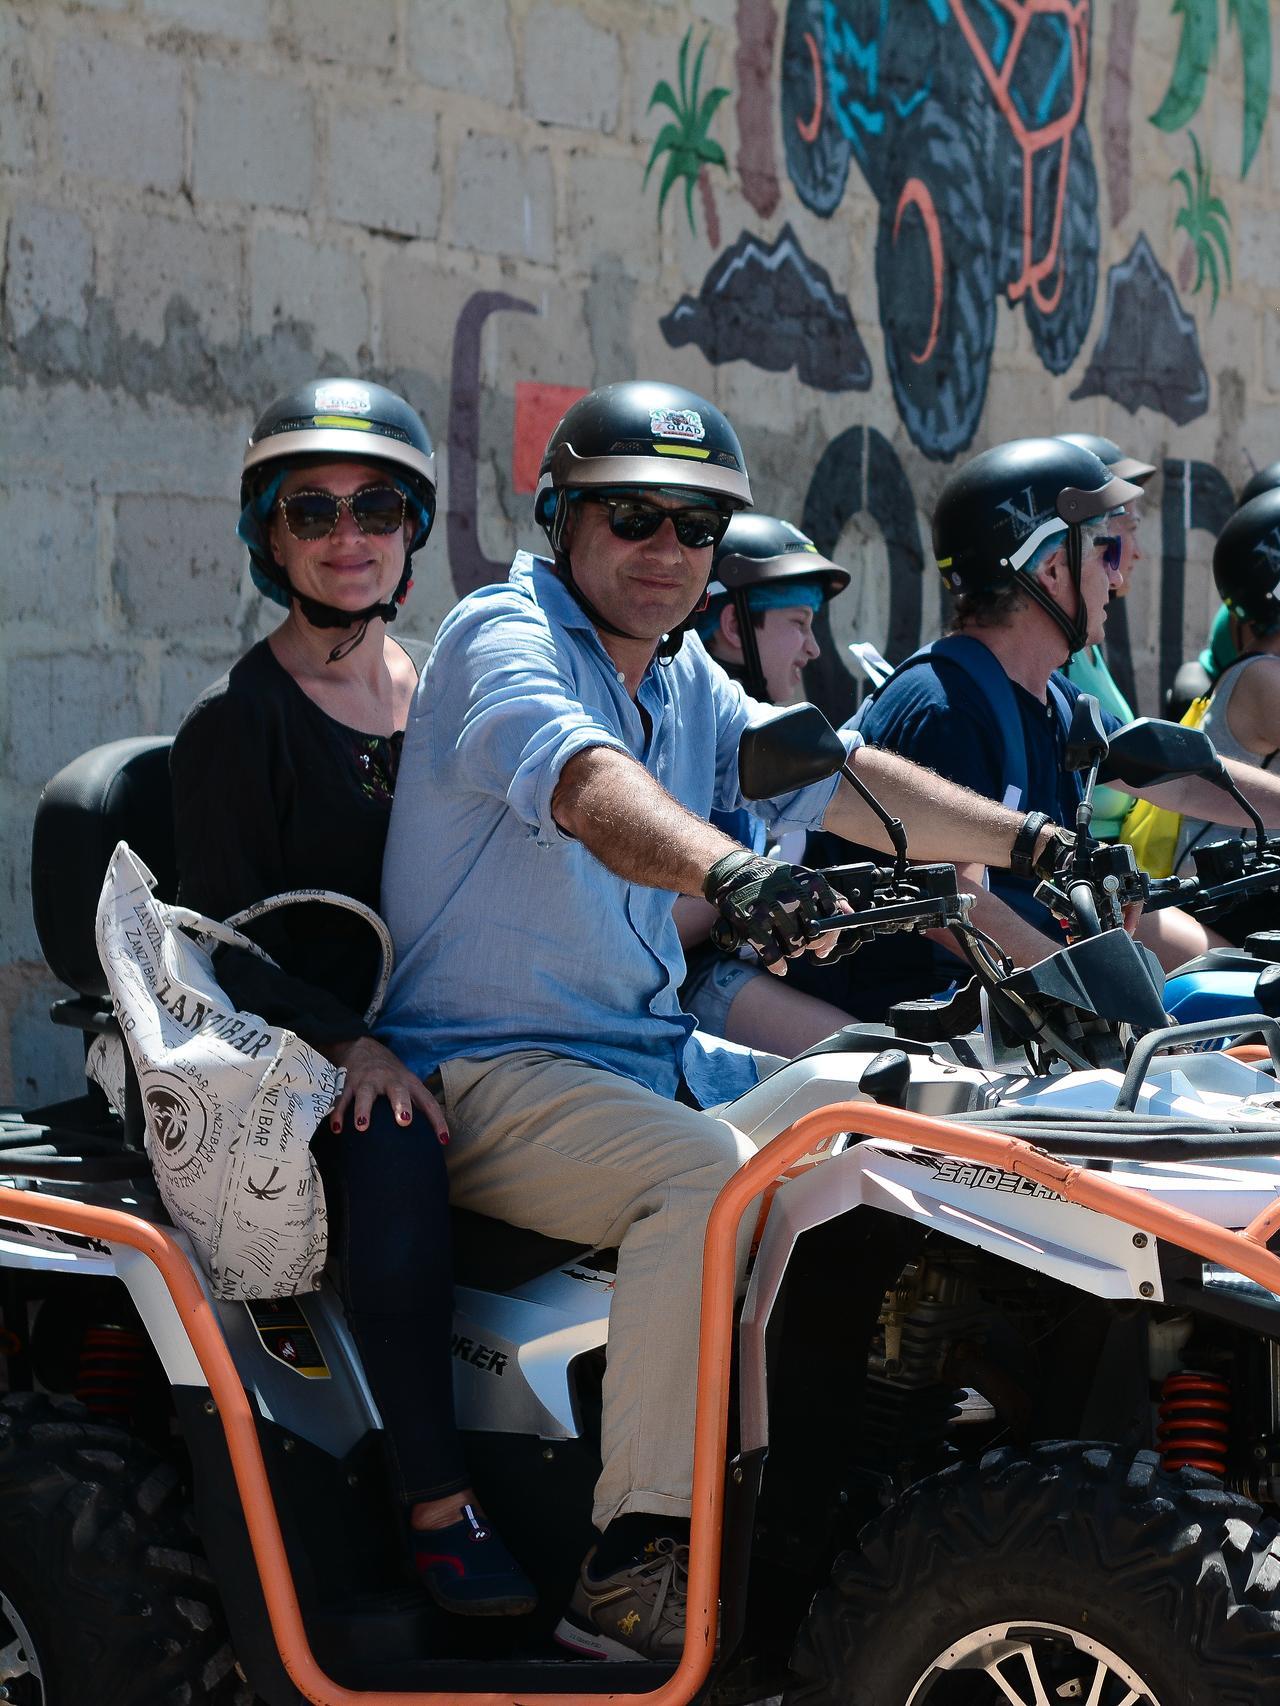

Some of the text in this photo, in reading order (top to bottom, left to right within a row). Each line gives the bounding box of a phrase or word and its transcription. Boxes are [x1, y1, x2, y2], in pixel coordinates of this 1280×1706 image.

[666, 424, 701, 435] QUAD
[125, 927, 158, 990] ZANZIBAR
[155, 976, 272, 1060] ZANZIBAR
